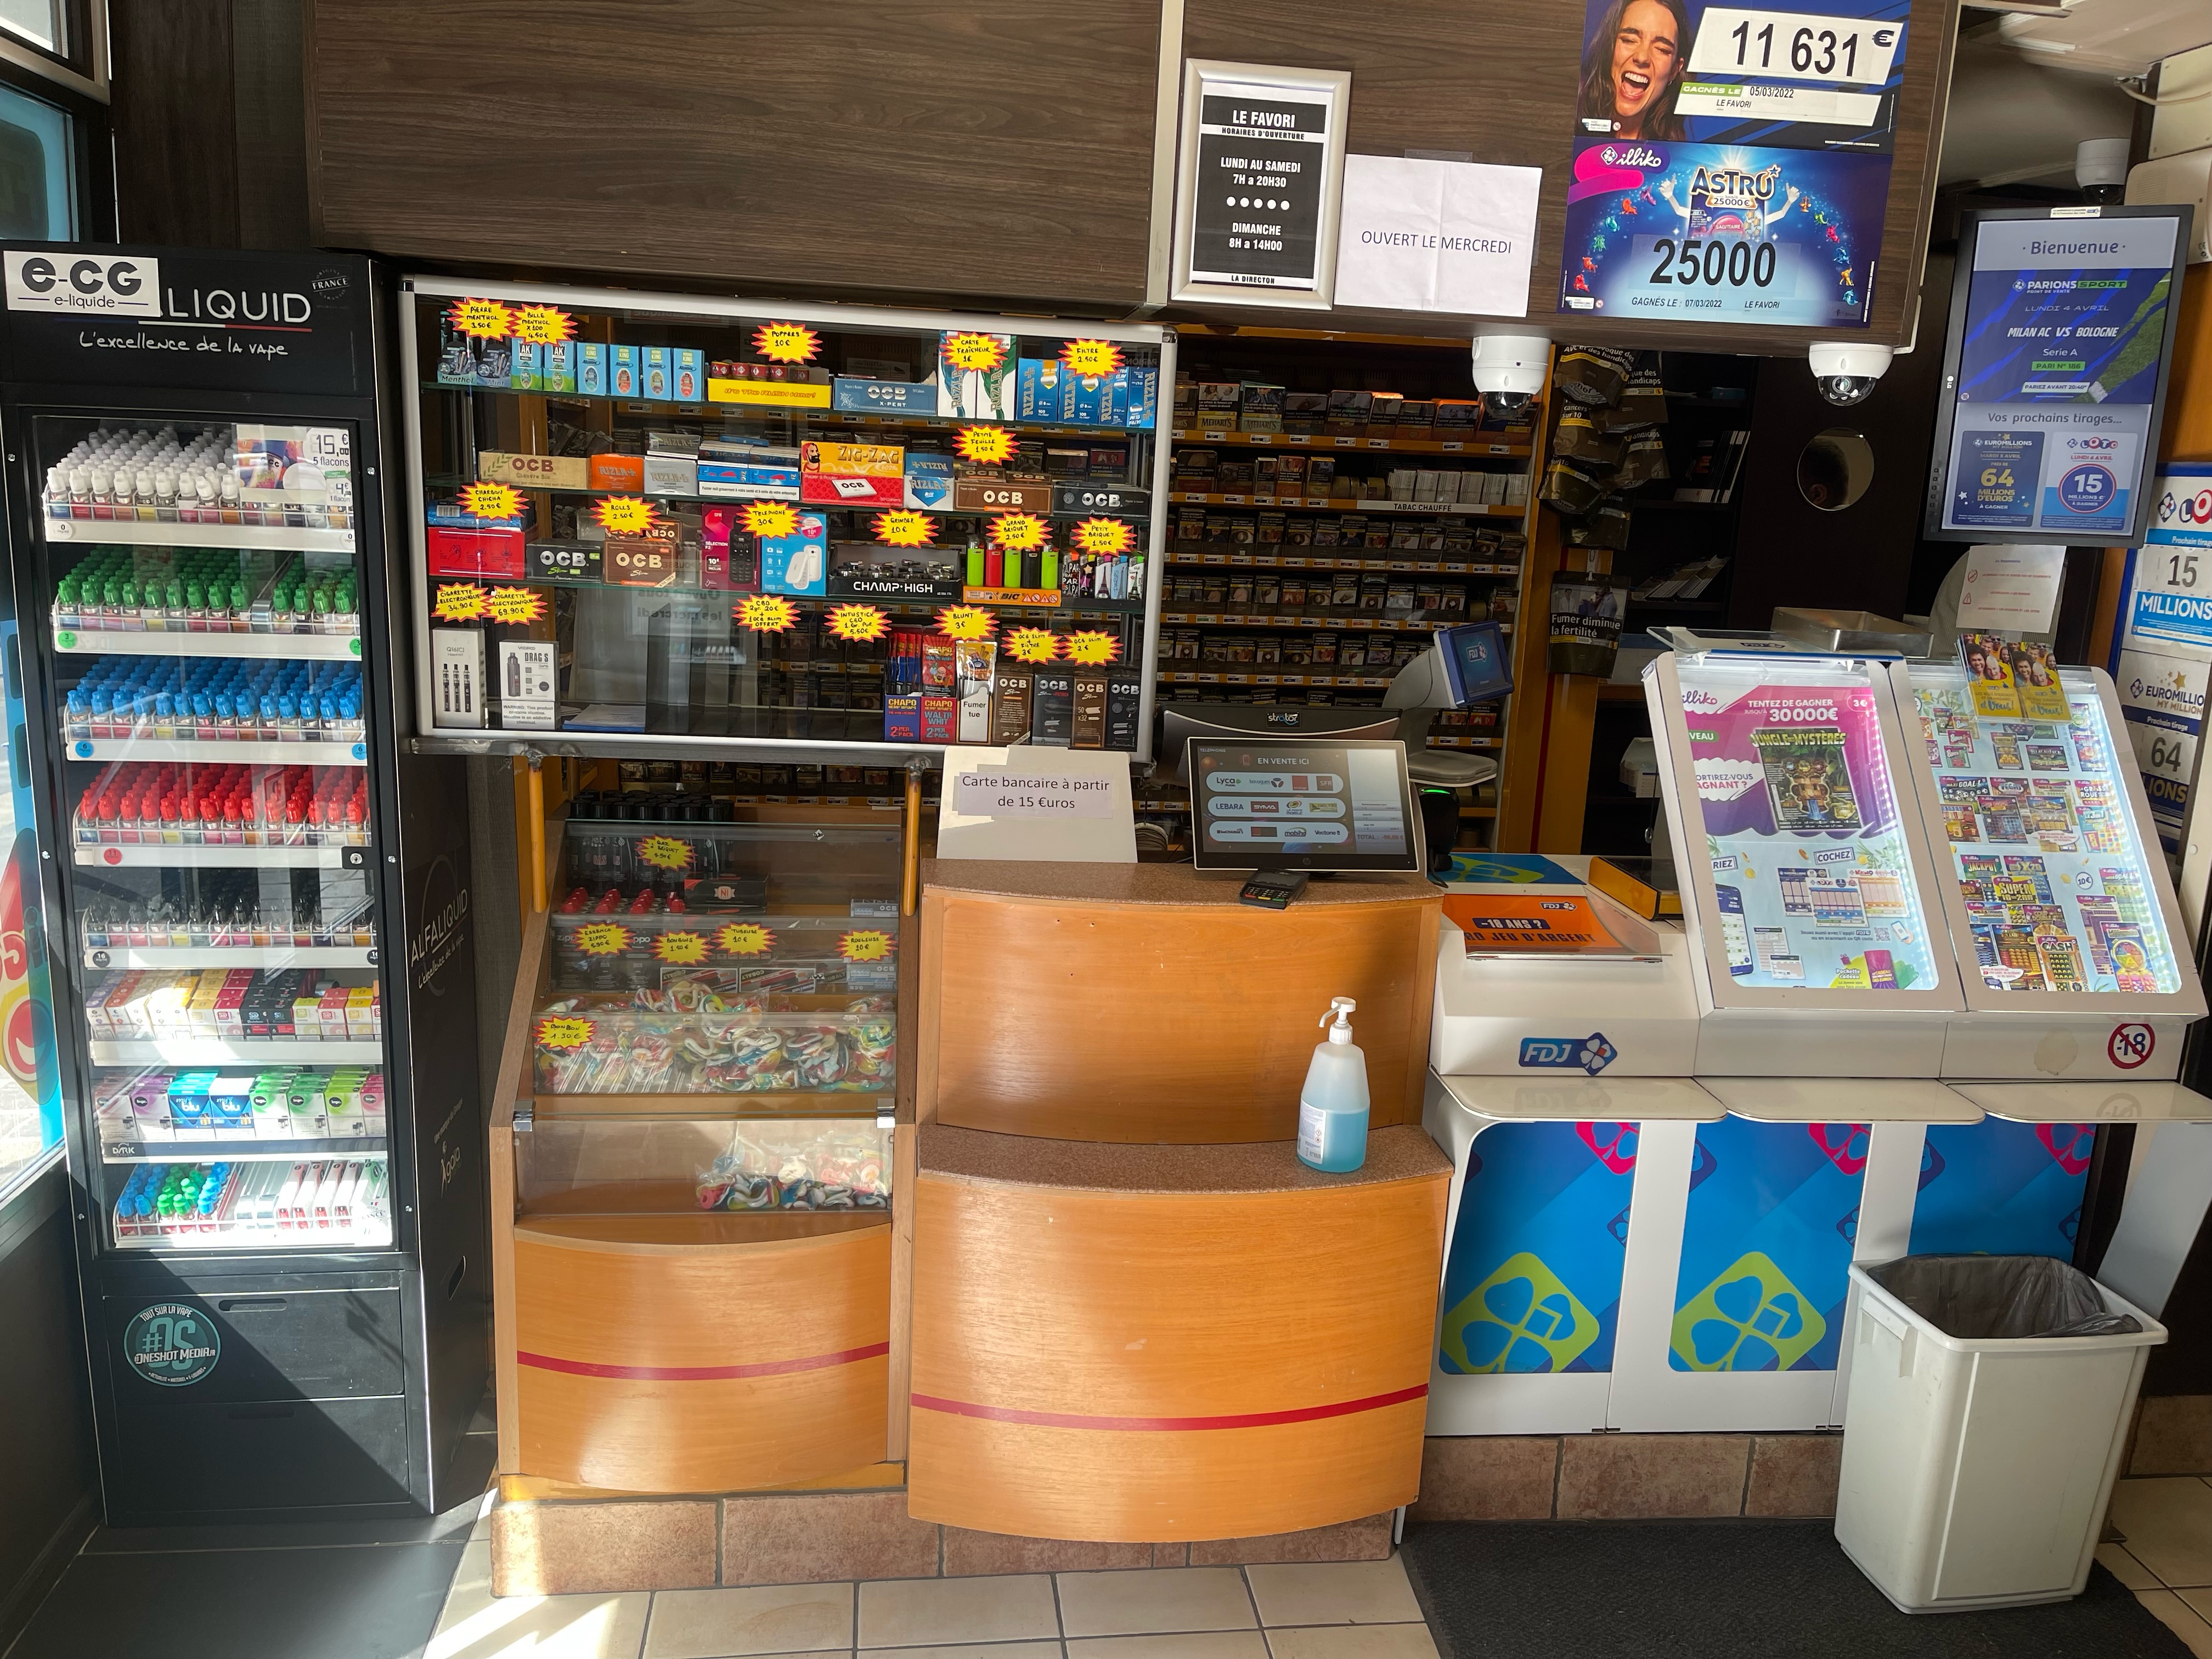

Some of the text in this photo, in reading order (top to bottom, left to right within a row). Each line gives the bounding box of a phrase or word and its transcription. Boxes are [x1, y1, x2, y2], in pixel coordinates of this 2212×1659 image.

[1733, 21, 1894, 77] 11 631 €
[1683, 84, 1794, 98] GAGNÉS LE 05/03/2022
[1716, 99, 1752, 108] LE FAVORI
[1233, 110, 1295, 127] LE FAVORI
[1222, 127, 1305, 140] HORAIRES D'OUVERTURE
[1616, 147, 1661, 167] illiko
[1221, 157, 1301, 173] LUNDI AU SAMEDI
[1233, 174, 1286, 187] 7H a 20H30
[1232, 223, 1281, 236] DIMANCHE
[1229, 239, 1282, 251] 8H a 14H00
[1362, 231, 1512, 254] OUVERT LE MERCREDI
[2031, 241, 2119, 255] Bienvenue
[1650, 240, 1776, 287] 25000
[21, 257, 142, 295] e-CG
[1242, 276, 1275, 285] DIRECTON
[312, 277, 348, 290] FRANCE
[2027, 280, 2077, 290] PARIONS
[54, 295, 115, 309] e-liquide
[1632, 297, 1722, 308] GAGNÉS LE 07/03/2022
[1755, 301, 1780, 309] FAVORI
[2007, 327, 2119, 337] MILAN AC VS BOLOGNE
[196, 336, 221, 352] de
[1077, 347, 1098, 355] FILTRE
[2042, 348, 2078, 357] Serie A
[1988, 412, 2122, 427] Vos prochains tirages...
[838, 445, 899, 463] ZIG-ZAG
[313, 456, 349, 467] 5 flacons
[512, 458, 553, 472] OCB
[1980, 469, 2015, 487] 64
[2074, 475, 2102, 493] 15
[983, 490, 1023, 504] OCB
[1081, 493, 1120, 506] OCB
[1394, 503, 1452, 512] TABAC CHAUFFÉ
[540, 551, 585, 566] OCB
[616, 553, 662, 568] OCB
[2168, 555, 2198, 588] 15
[2140, 594, 2212, 620] MILLIONS
[1551, 614, 1621, 629] Fumer diminue
[1551, 626, 1597, 637] la fertilité
[1796, 698, 1833, 707] GAGNER
[2170, 704, 2203, 715] MILLION
[2147, 716, 2188, 731] Prochain tirage
[1795, 731, 1847, 746] MYSTÈRES
[2151, 737, 2182, 772] 64
[962, 776, 1110, 794] Carte bancaire à partir
[997, 795, 1075, 809] de 15 €uros
[1817, 850, 1851, 862] COCHEZ
[1507, 919, 1532, 929] ANS
[1534, 919, 1543, 929] ?
[1492, 933, 1595, 943] JEU D'ARGENT
[2117, 1032, 2146, 1056] -18
[1524, 1043, 1572, 1063] FDJ
[140, 1306, 193, 1322] TOUT SUR LA VAPE
